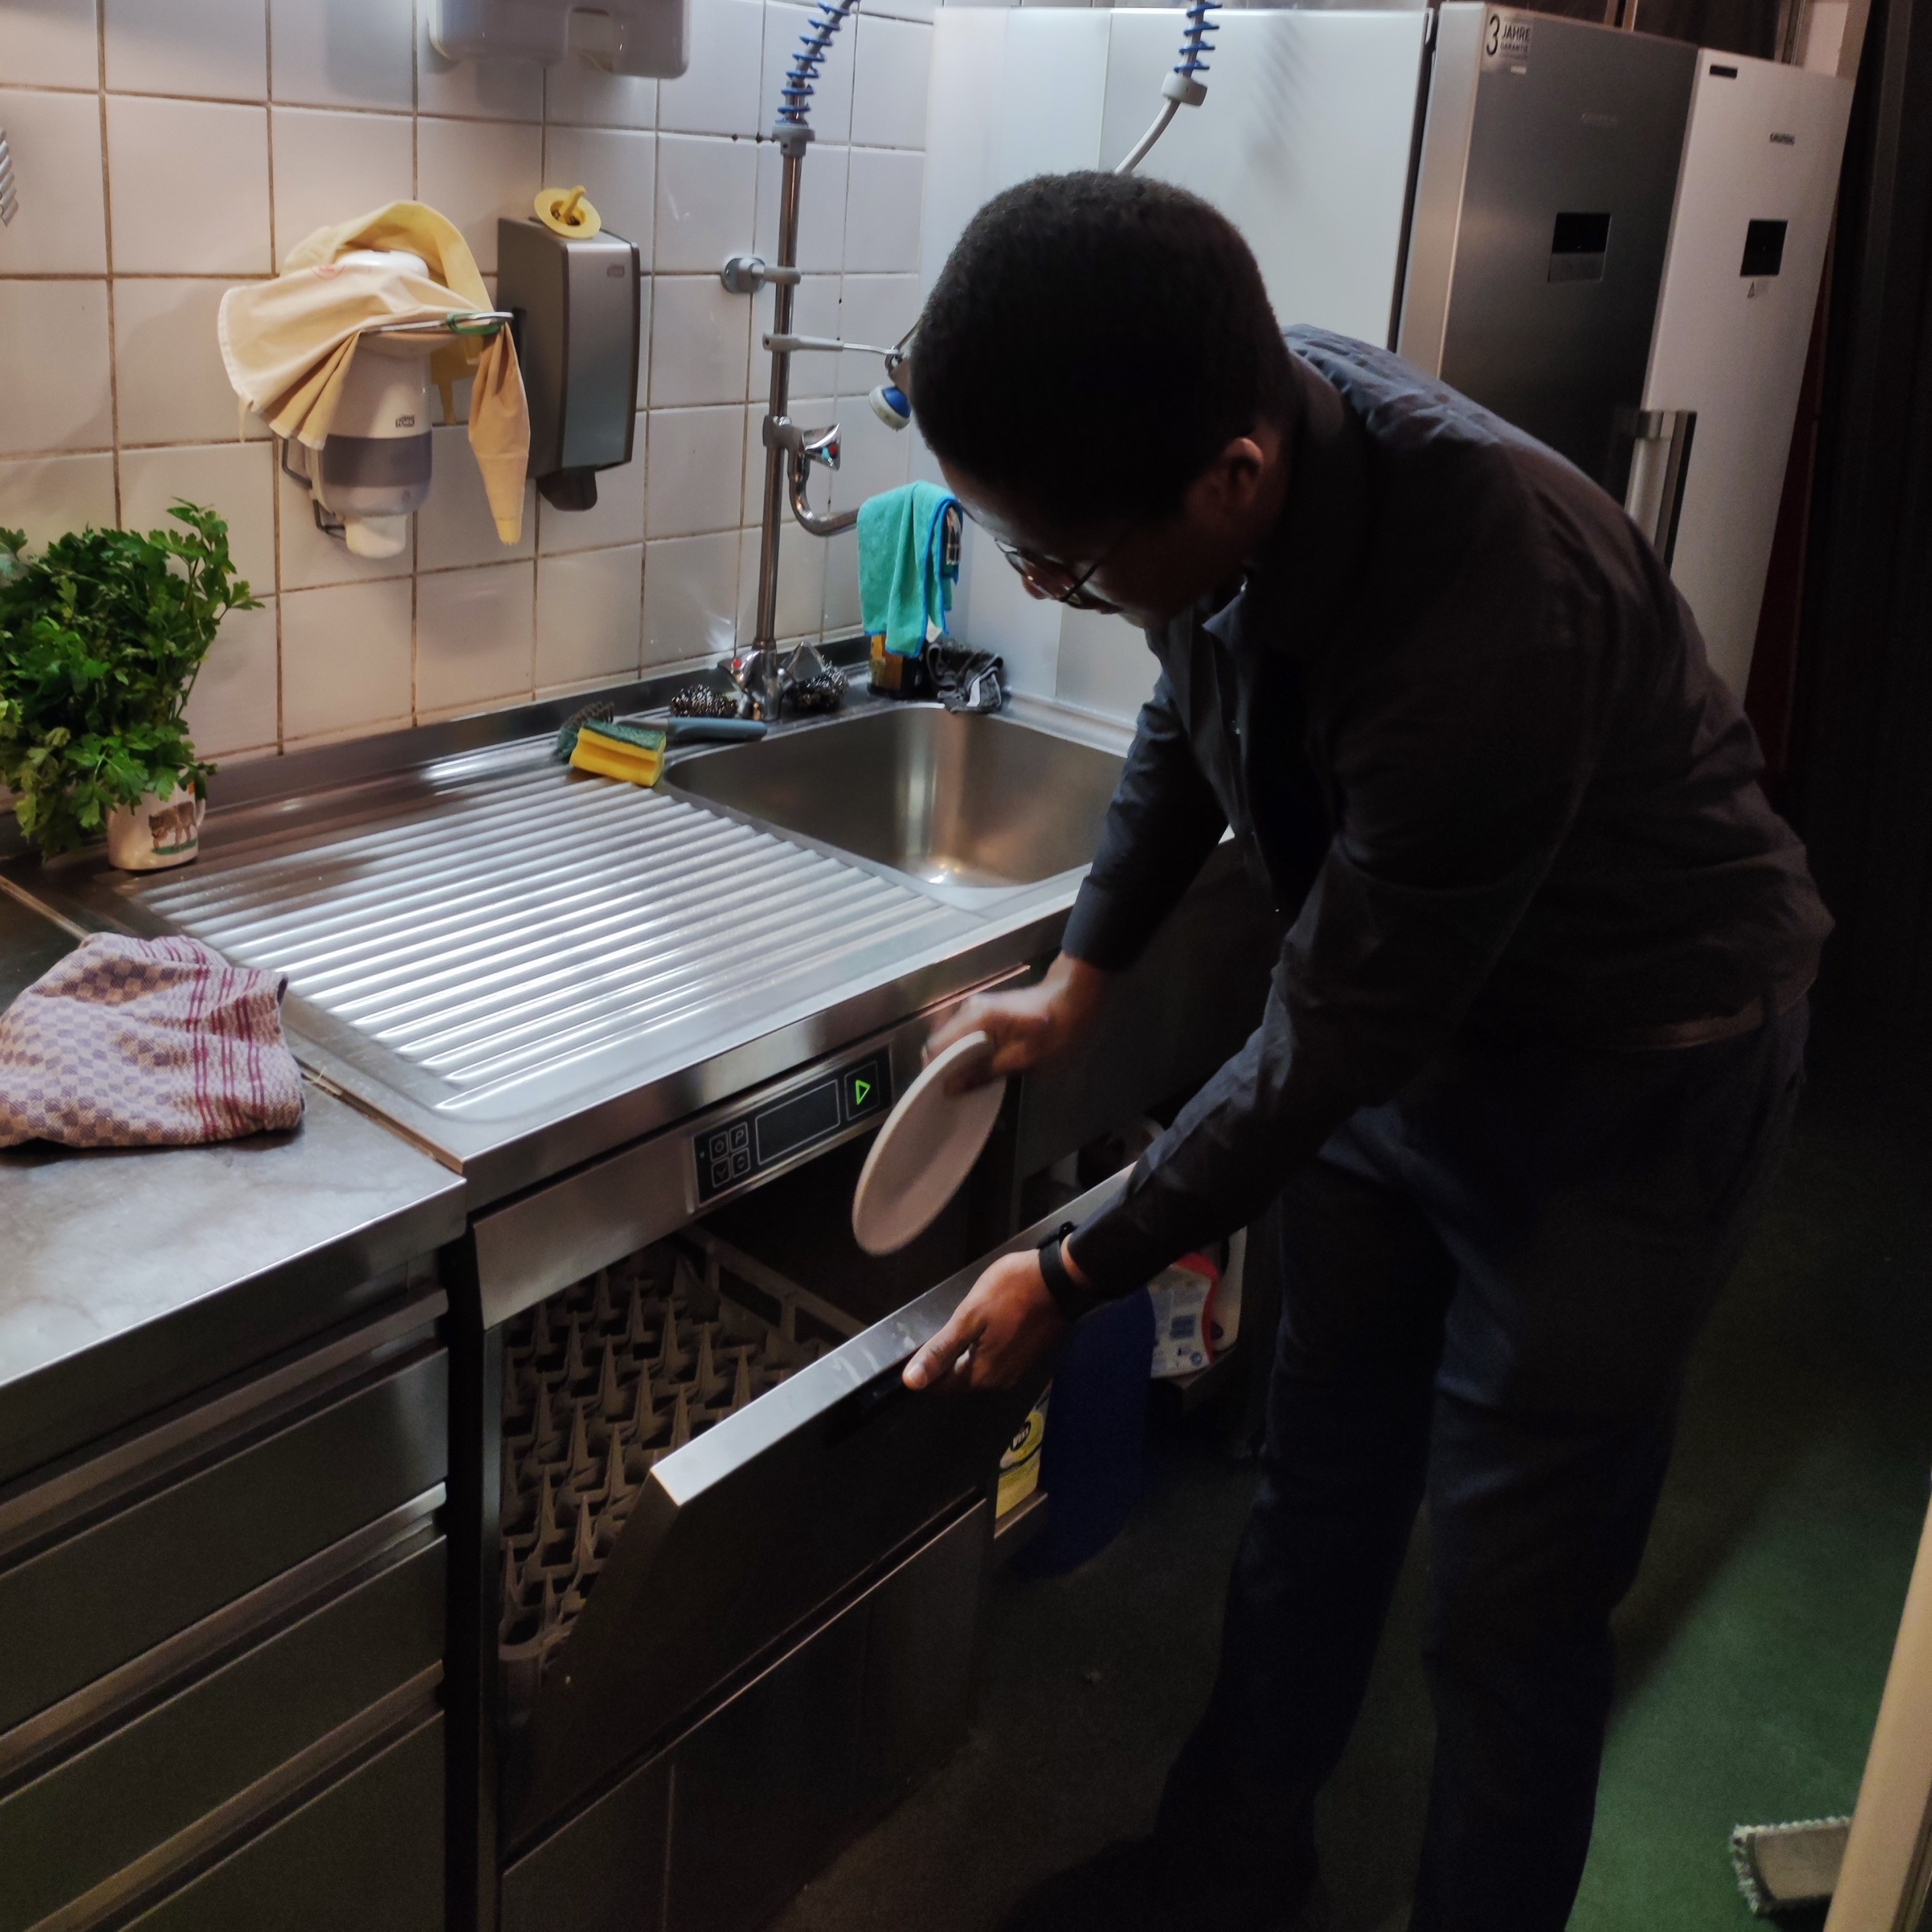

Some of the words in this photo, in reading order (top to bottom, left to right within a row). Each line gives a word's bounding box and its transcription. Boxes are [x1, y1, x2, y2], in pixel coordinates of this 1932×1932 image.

[1486, 14, 1500, 56] 3
[1503, 24, 1531, 41] JAHRE
[735, 1129, 744, 1145] P
